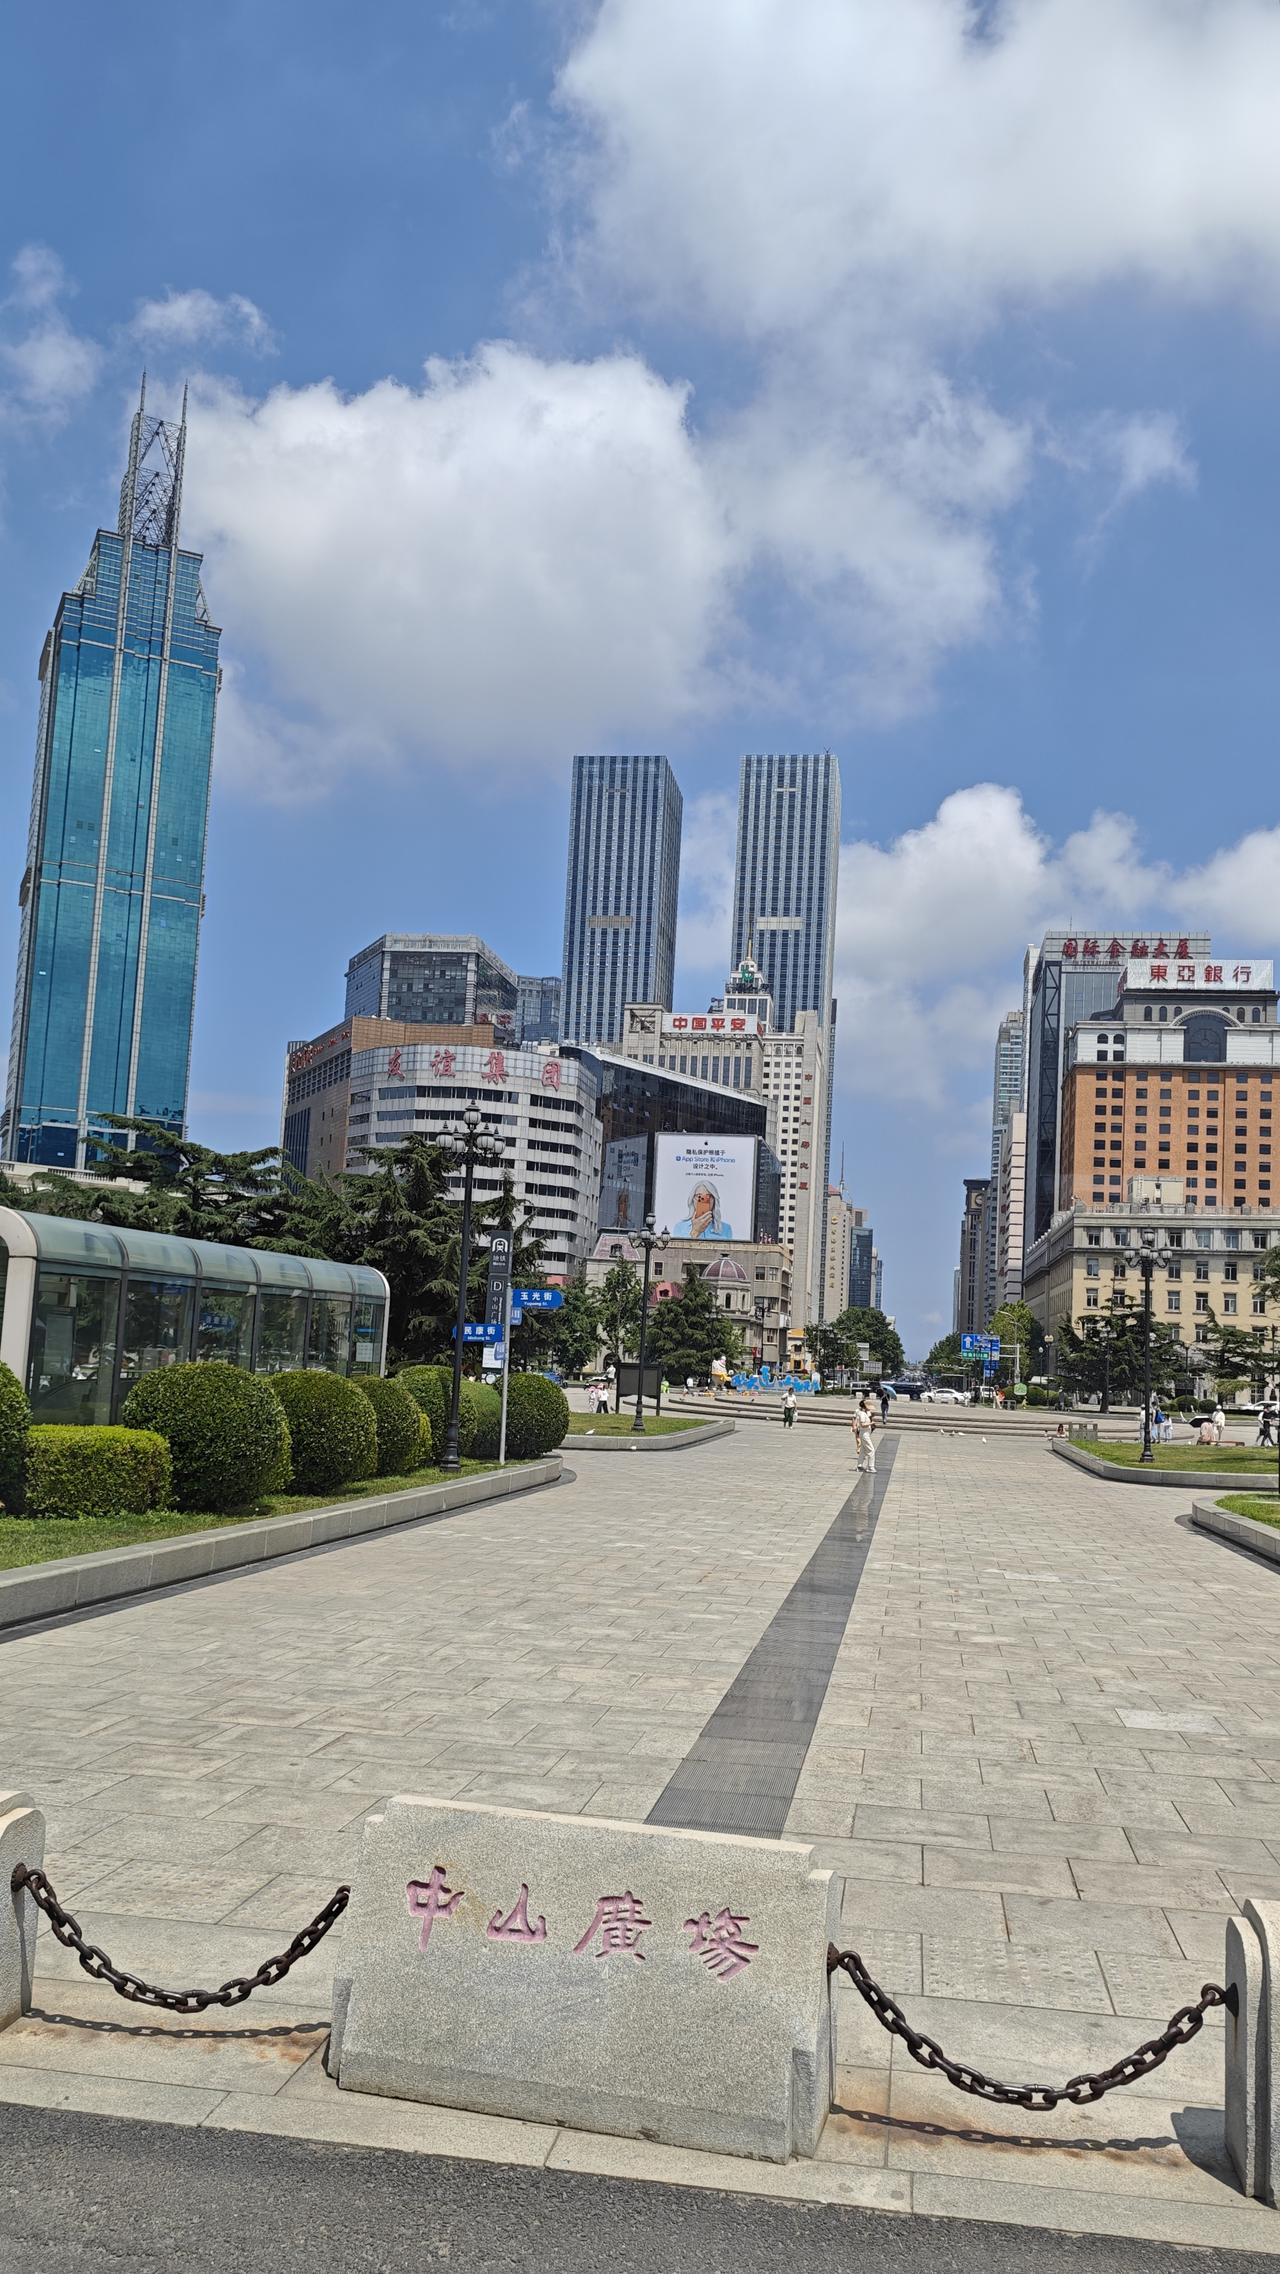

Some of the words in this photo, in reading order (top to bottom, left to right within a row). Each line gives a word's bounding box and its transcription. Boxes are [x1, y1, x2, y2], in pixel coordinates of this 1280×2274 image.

[1062, 938, 1193, 959] 国际金融大厦
[1150, 964, 1252, 984] 東亞銀行
[672, 1016, 746, 1032] 中国平安
[387, 1048, 561, 1092] 友谊集团
[493, 1281, 502, 1291] D
[520, 1292, 552, 1301] 玉光街
[464, 1327, 495, 1335] 民康街
